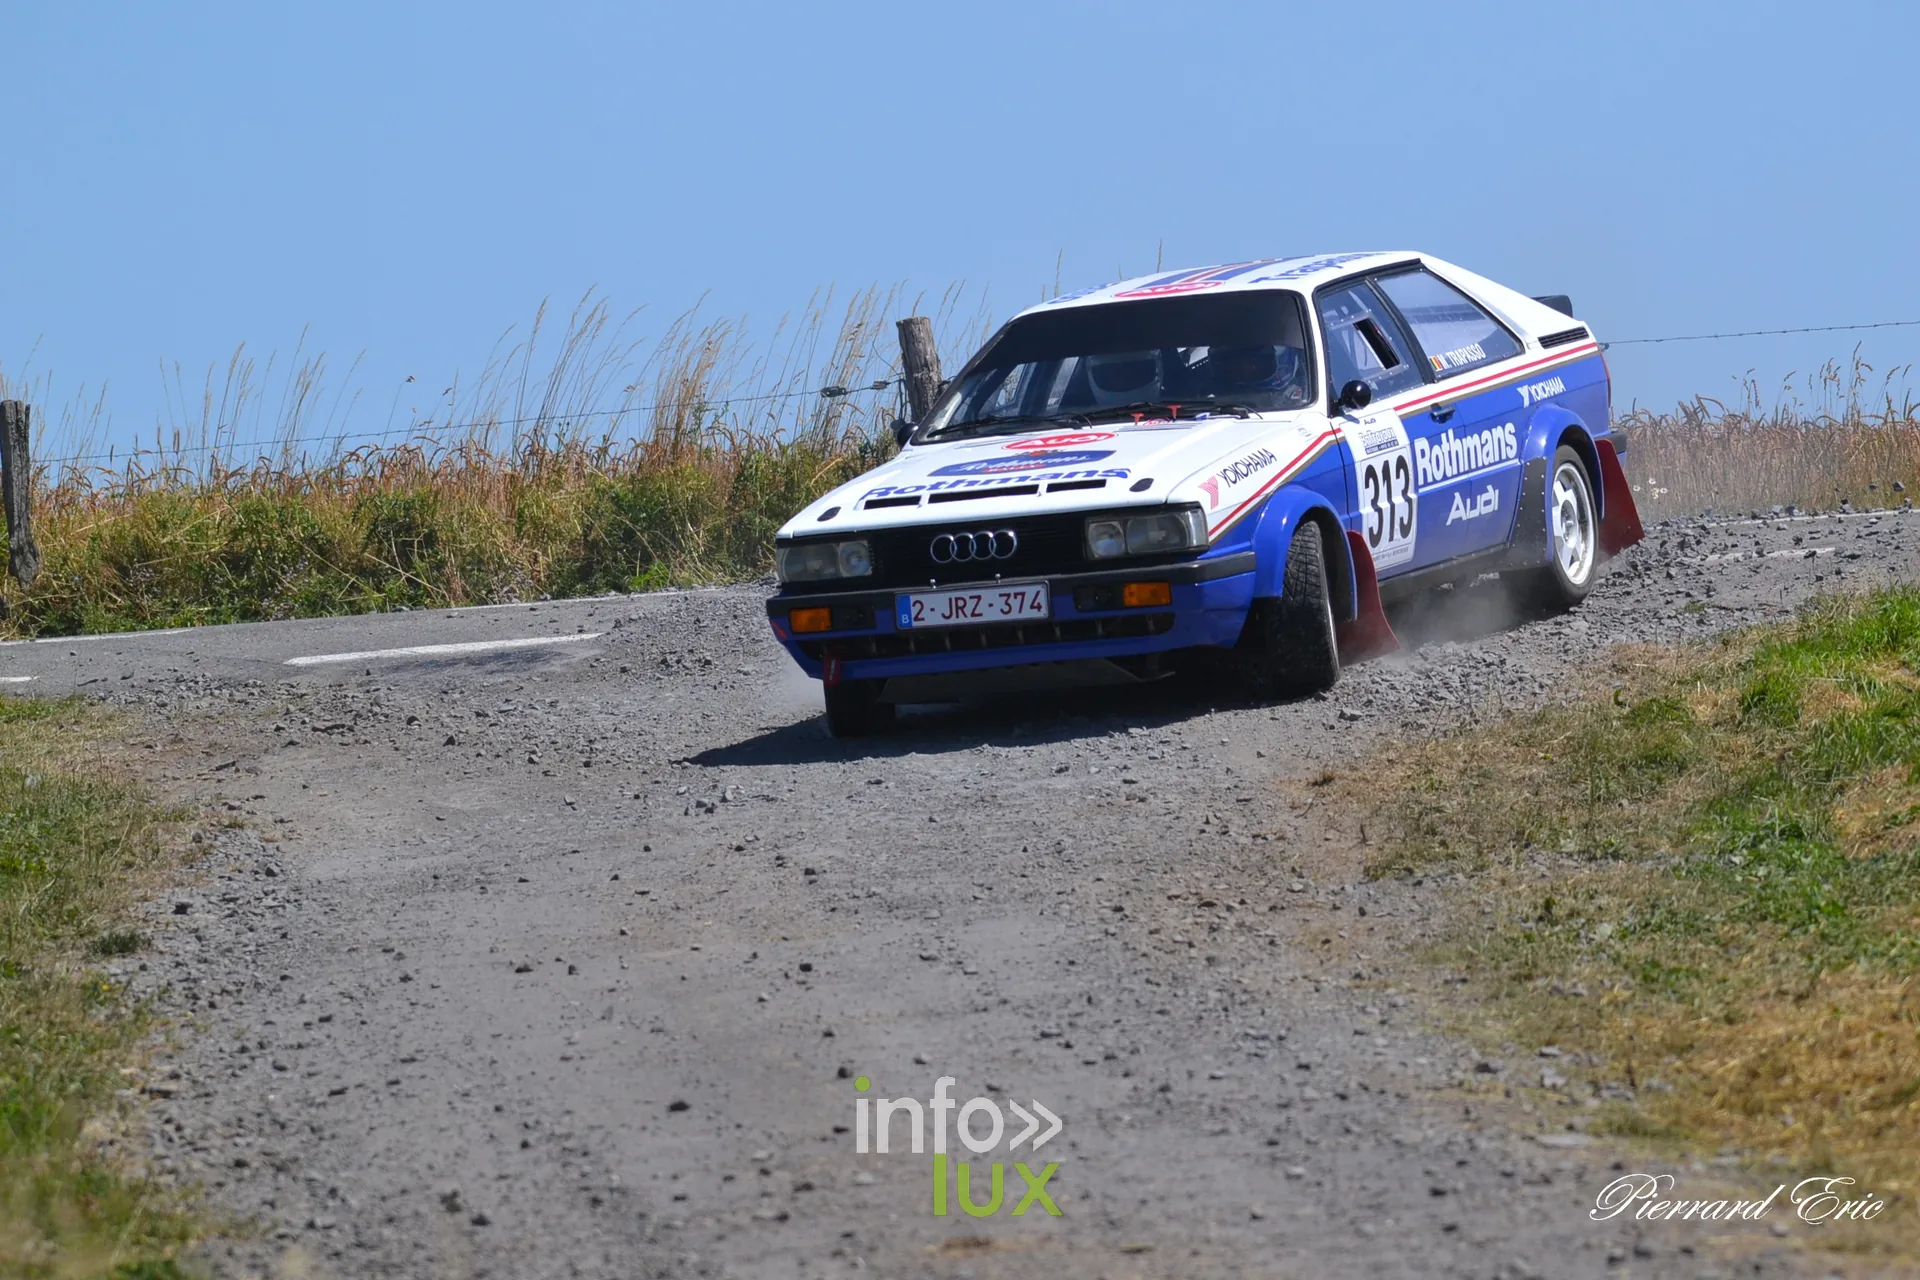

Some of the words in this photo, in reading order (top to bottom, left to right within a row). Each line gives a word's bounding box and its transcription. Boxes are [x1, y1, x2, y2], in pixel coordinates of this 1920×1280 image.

[1446, 343, 1486, 367] TRAPASSO
[1528, 376, 1567, 402] YOKOHAMA
[1216, 447, 1278, 488] YOKOHAMA
[1414, 422, 1517, 486] Rothmans
[858, 467, 1132, 502] Rothmans
[1364, 455, 1413, 548] 313
[1445, 484, 1499, 526] Audi
[901, 614, 910, 624] B
[911, 590, 1042, 622] 2-JRZ-374
